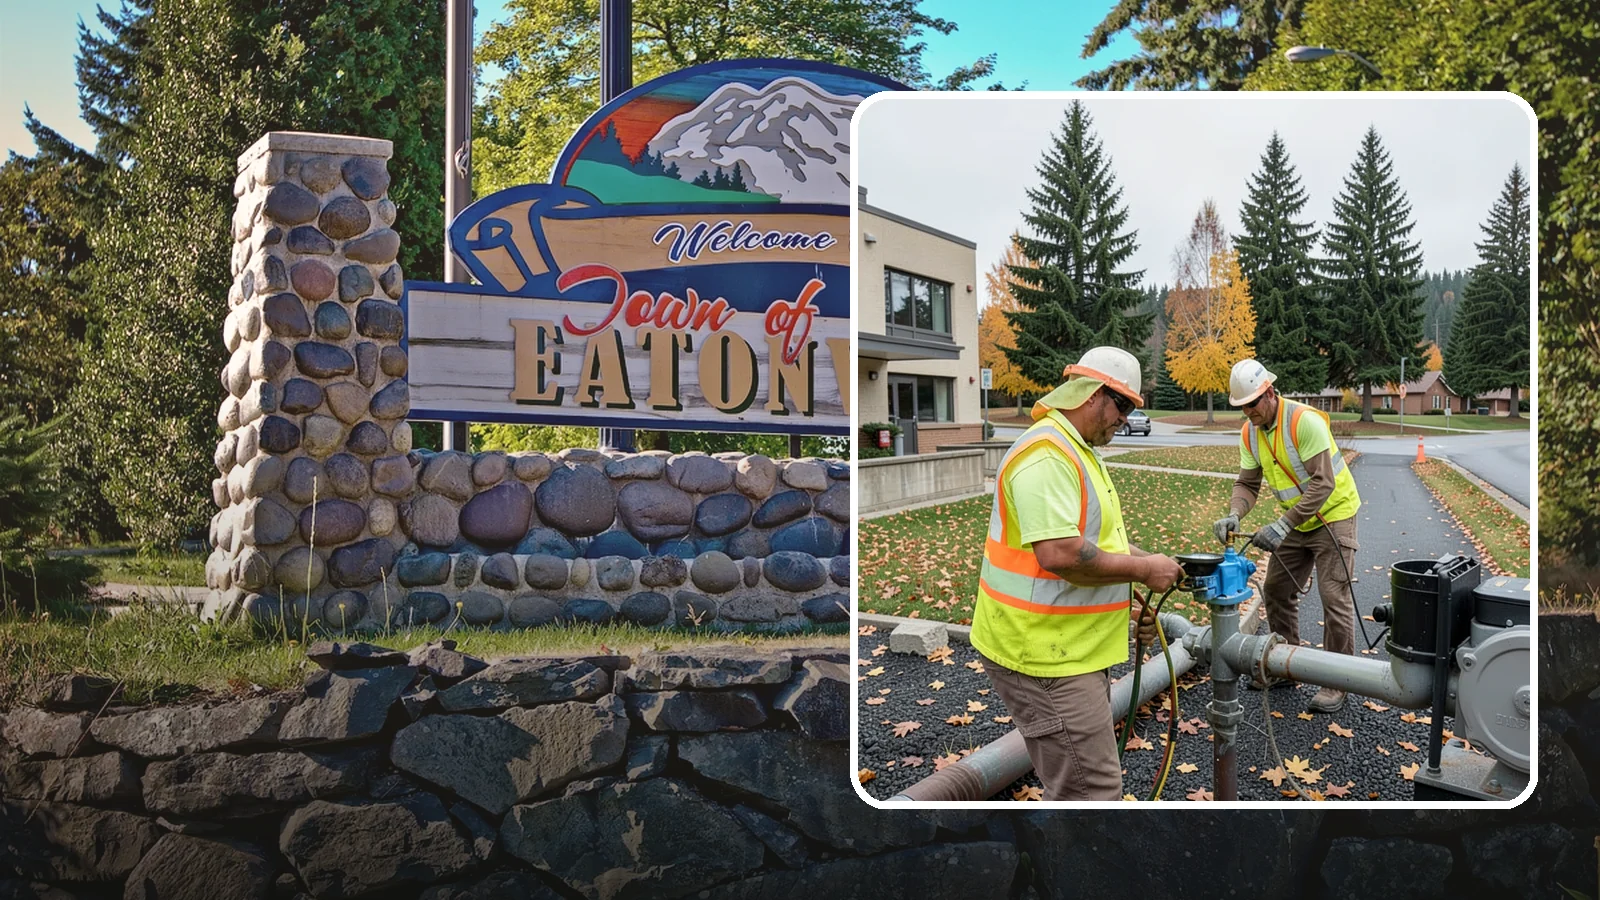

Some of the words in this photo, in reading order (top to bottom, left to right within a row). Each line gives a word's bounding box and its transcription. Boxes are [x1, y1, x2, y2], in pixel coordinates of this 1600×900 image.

[653, 220, 837, 264] Welcome
[556, 263, 737, 336] Town
[764, 278, 826, 365] of
